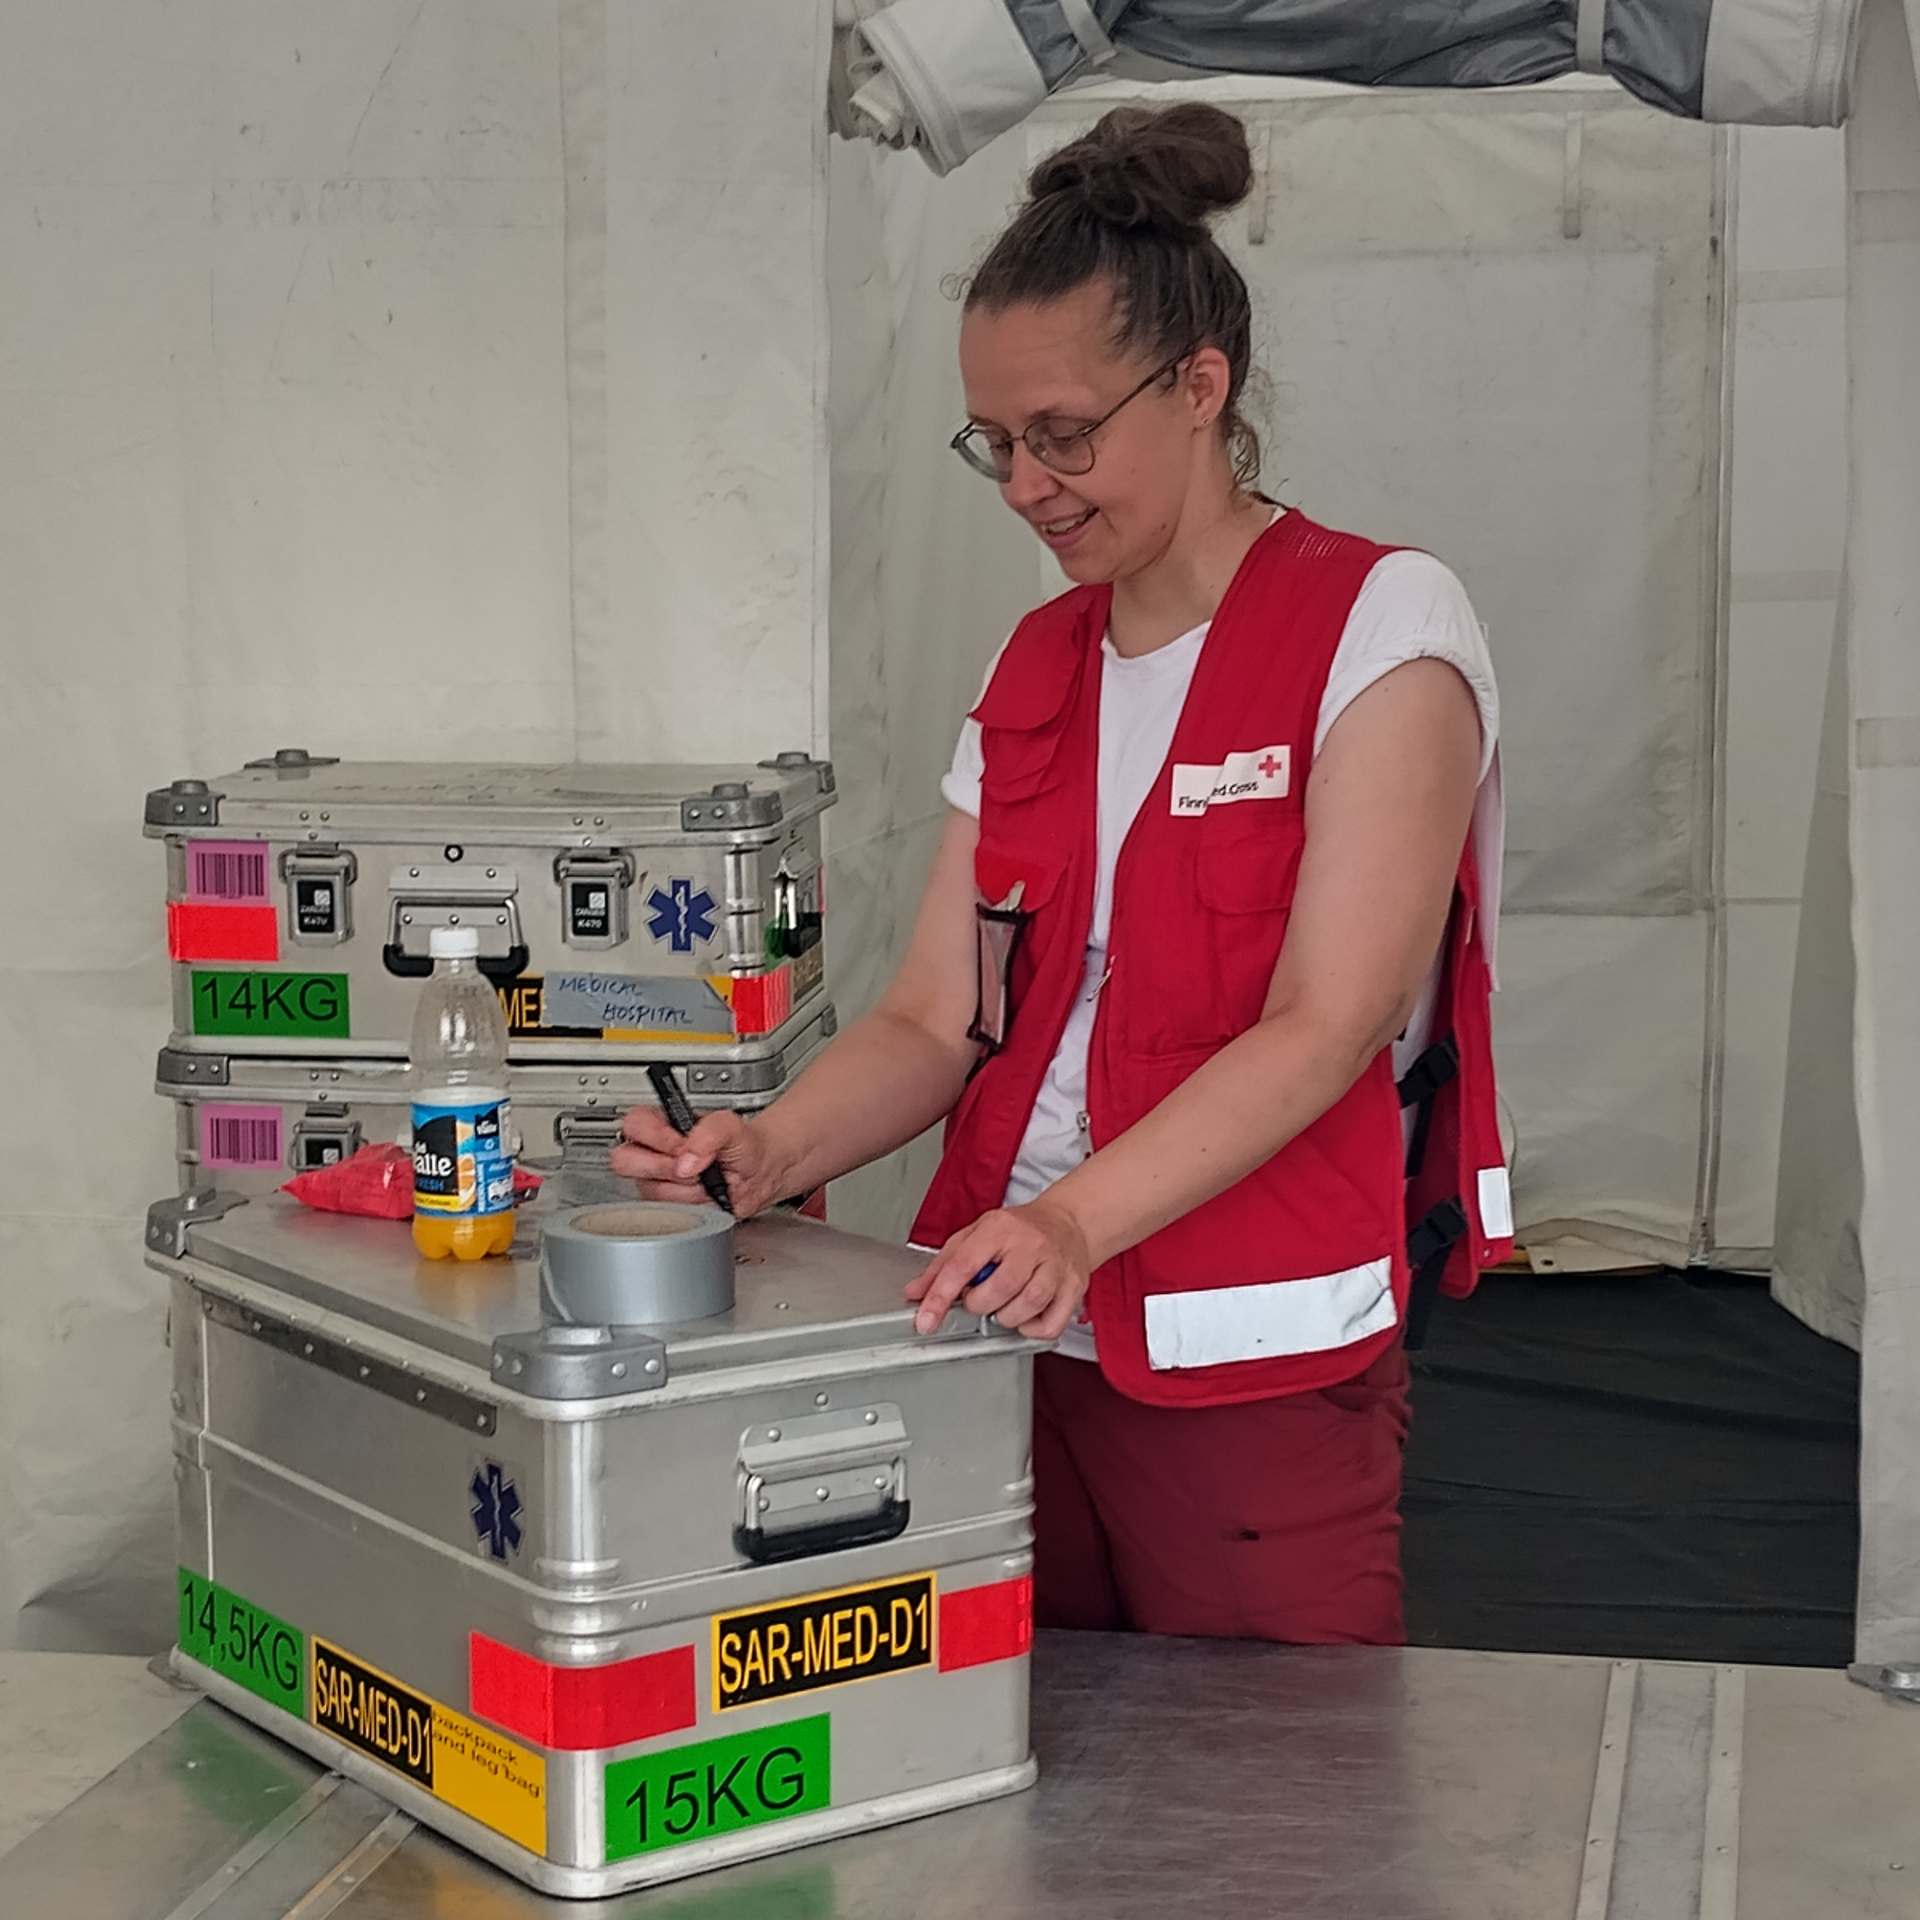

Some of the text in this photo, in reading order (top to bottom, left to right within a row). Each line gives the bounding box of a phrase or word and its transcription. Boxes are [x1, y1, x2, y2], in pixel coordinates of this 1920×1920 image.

[201, 977, 338, 1021] 14KG
[559, 973, 643, 997] MEDICAL
[602, 1002, 693, 1025] HOSPITAL
[415, 1153, 455, 1177] alle
[183, 1580, 298, 1691] 14,5KG
[720, 1593, 928, 1694] SAR-MED-D1
[316, 1658, 432, 1775] SAR-MED-D1
[432, 1729, 542, 1799] and leg bag
[625, 1747, 806, 1844] 15KG
